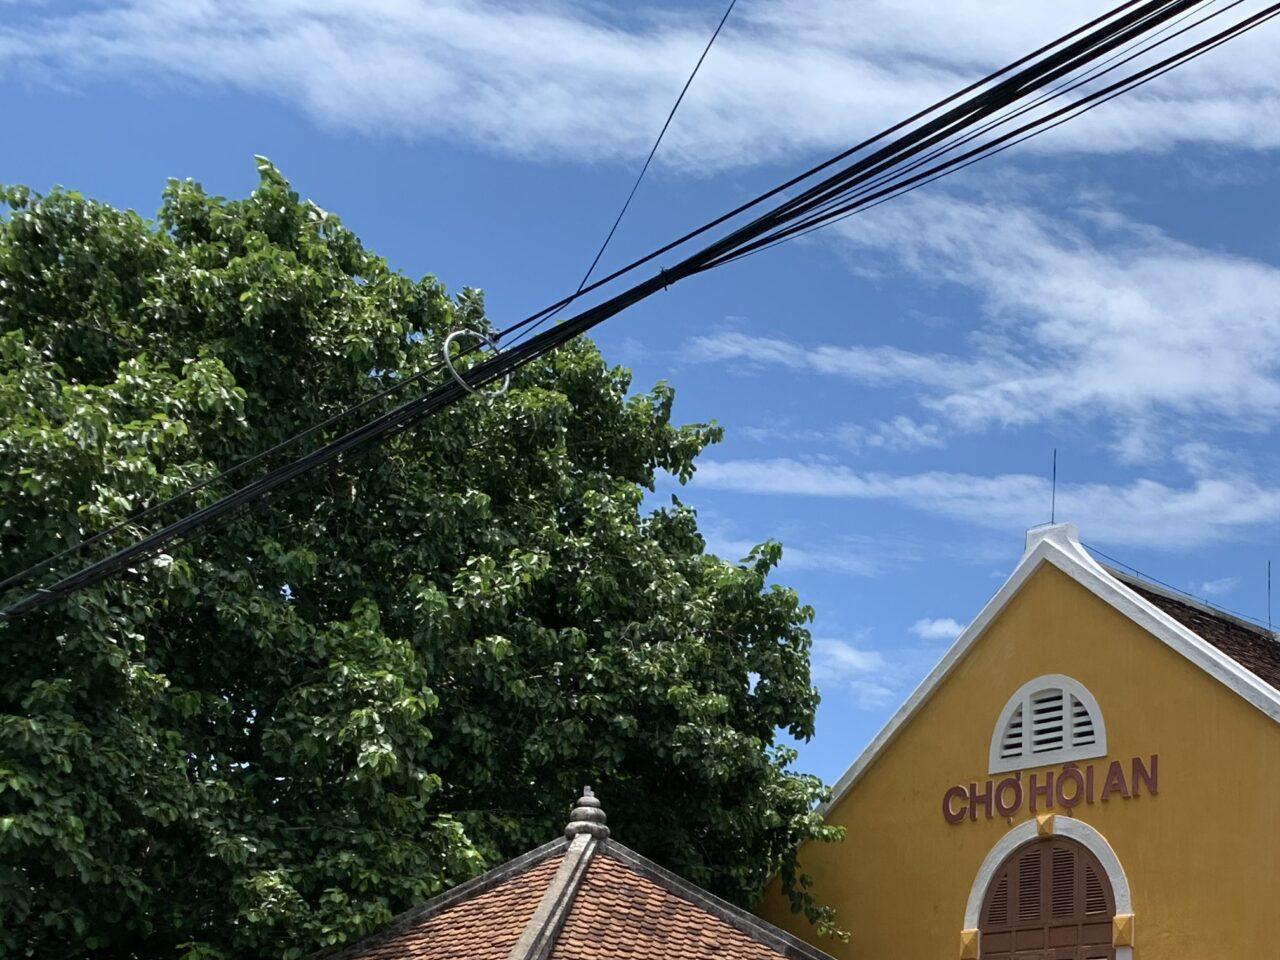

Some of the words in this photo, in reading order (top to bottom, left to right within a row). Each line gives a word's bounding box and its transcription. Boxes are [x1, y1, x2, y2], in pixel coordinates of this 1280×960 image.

[943, 771, 1023, 825] CHỢ
[1029, 762, 1094, 817] HỘI
[1101, 754, 1159, 801] AN
